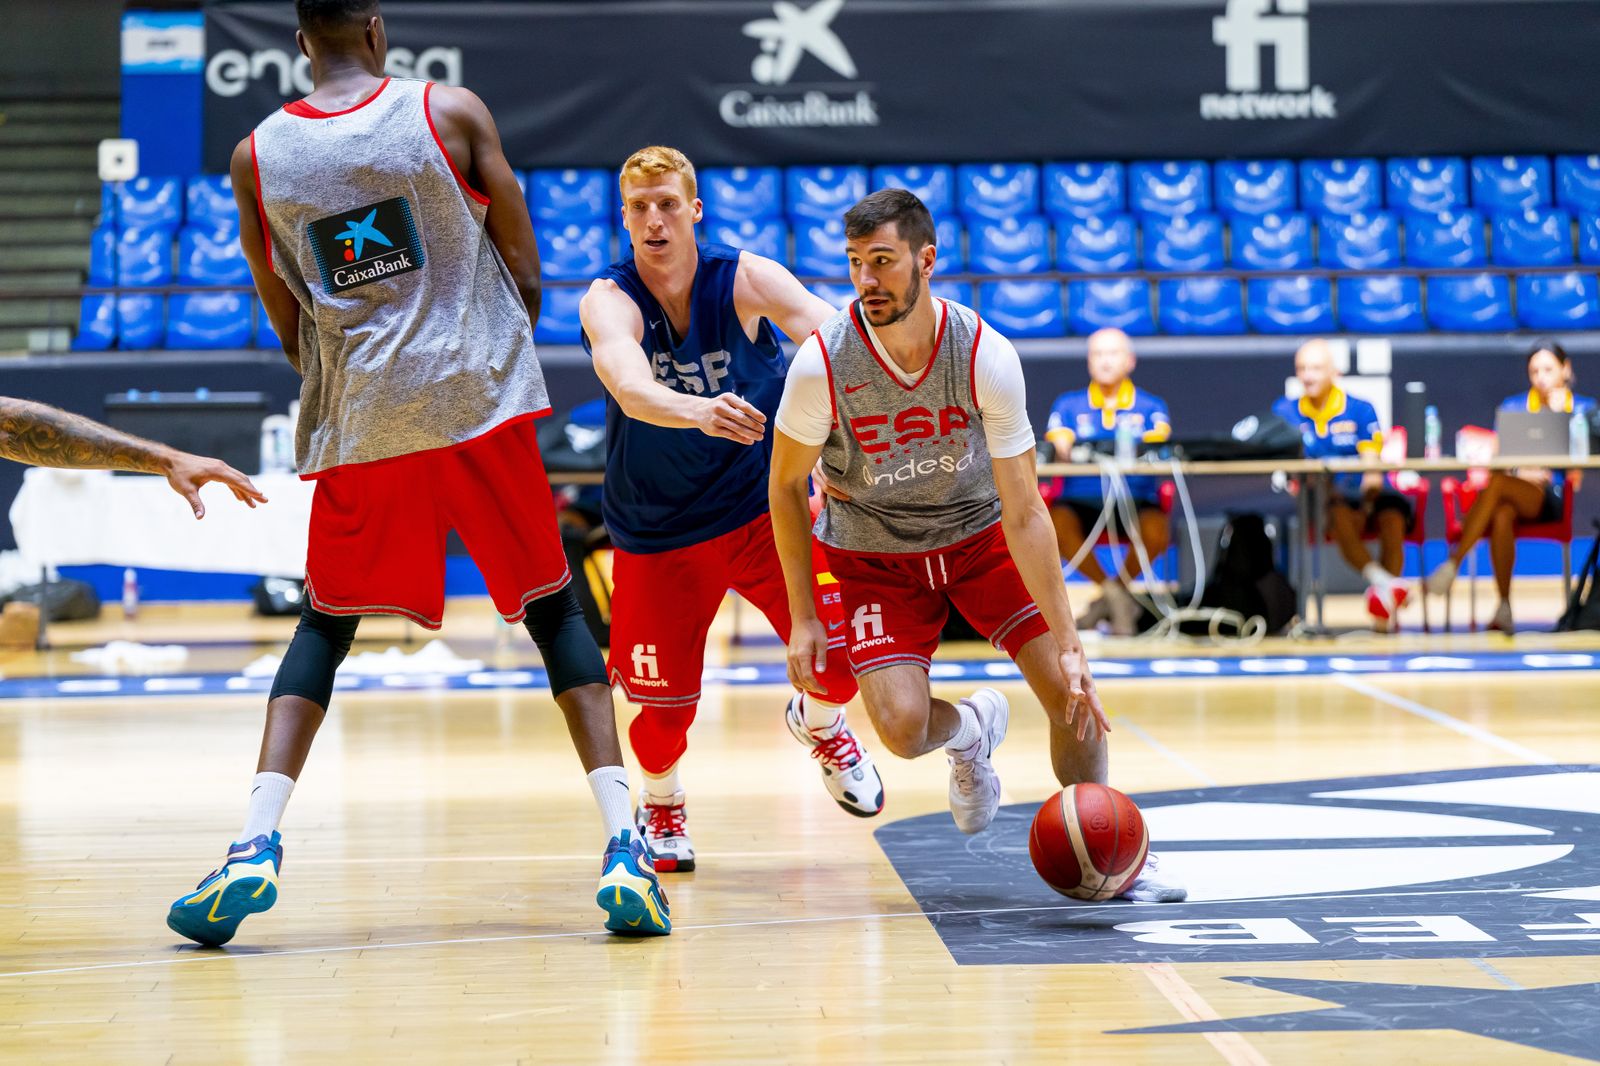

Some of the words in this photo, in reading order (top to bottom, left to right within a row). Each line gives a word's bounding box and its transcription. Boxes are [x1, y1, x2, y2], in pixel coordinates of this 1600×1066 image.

[206, 47, 463, 97] ensa
[719, 90, 880, 128] CaixaBank
[1200, 85, 1337, 120] network
[334, 254, 412, 287] CaixaBank
[651, 349, 731, 394] ESP
[849, 405, 970, 454] ESP
[822, 592, 842, 605] ES
[851, 603, 884, 641] fi
[631, 643, 659, 678] fi
[851, 635, 895, 653] network
[629, 676, 669, 687] network
